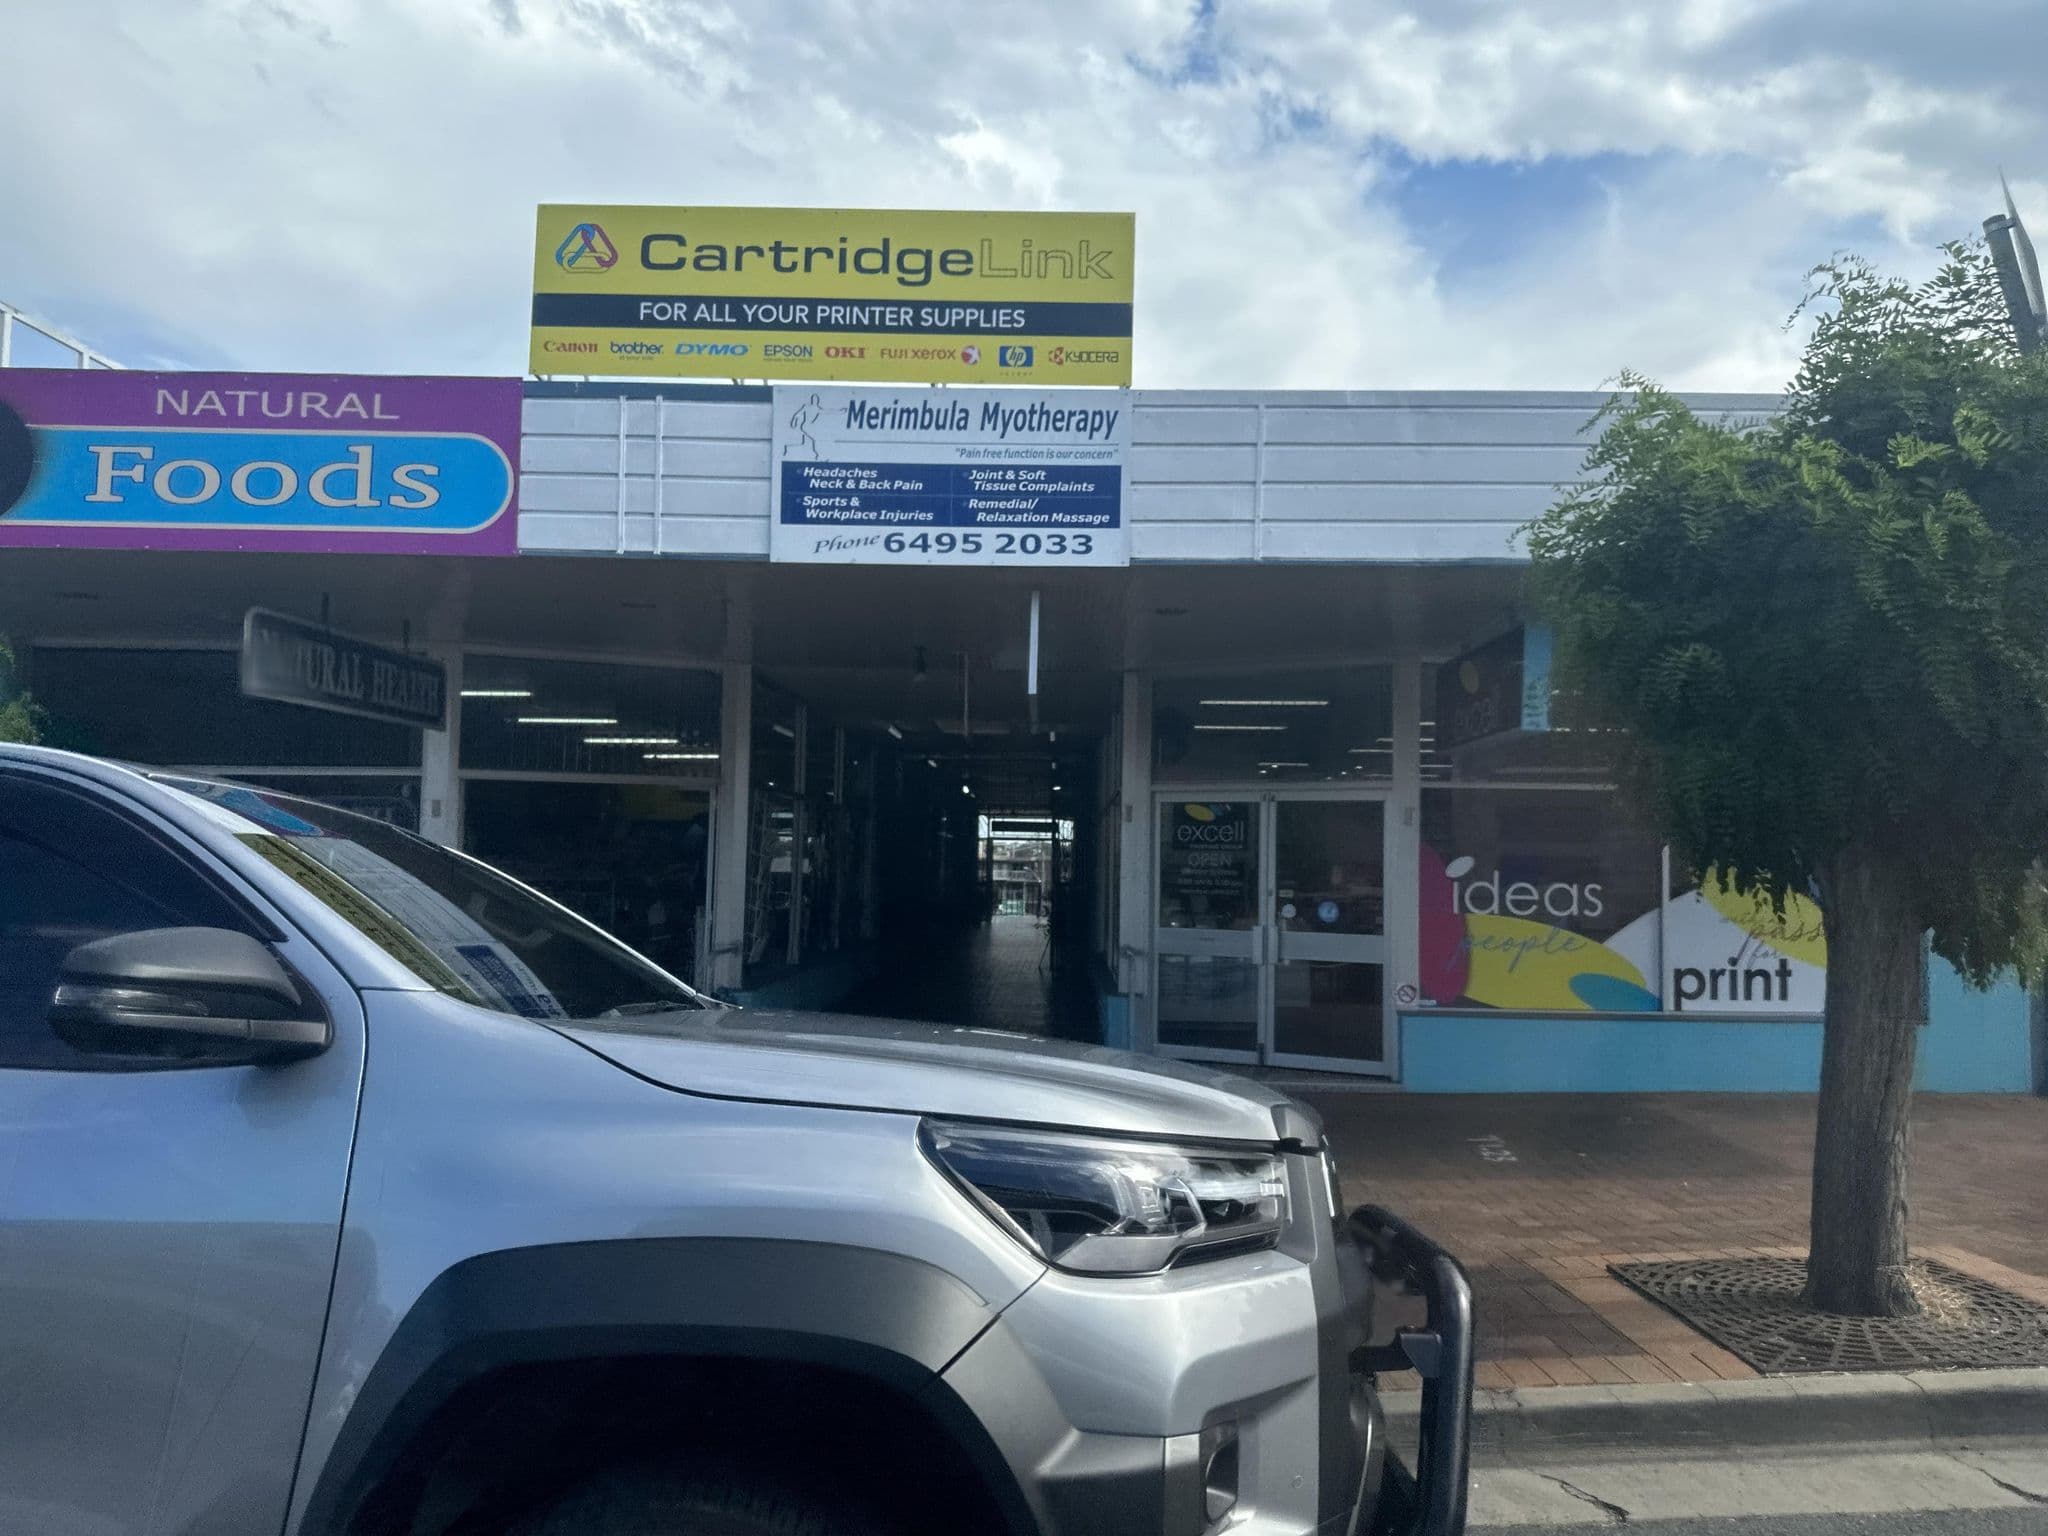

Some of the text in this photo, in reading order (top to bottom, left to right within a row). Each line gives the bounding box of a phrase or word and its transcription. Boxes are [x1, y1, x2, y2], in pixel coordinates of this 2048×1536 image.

[640, 233, 1114, 286] CartridgeLink
[640, 302, 1025, 328] FOR ALL YOUR PRINTER SUPPLIES
[543, 340, 598, 353] Canon
[610, 342, 664, 355] brother
[675, 344, 748, 356] DYMO
[764, 345, 813, 359] EPSON
[825, 346, 867, 359] OKI
[881, 347, 956, 361] FUJI xerox
[156, 390, 399, 419] NATURAL
[846, 399, 1119, 439] Merimbula Myotherapy
[955, 448, 1119, 460] "Pain free function is our concern"
[85, 445, 440, 509] Foods
[803, 467, 878, 478] Headaches
[969, 470, 1047, 480] Joint & Soft
[810, 479, 923, 491] Neck & Back Pain
[974, 481, 1095, 494] Tissue Complaints
[803, 496, 859, 508] Sports &
[969, 498, 1039, 510] Remedial/
[806, 509, 933, 523] Workplace Injuries
[977, 512, 1110, 525] Relaxation Massage
[884, 532, 982, 554] 6495
[995, 534, 1093, 555] 2033
[1177, 821, 1244, 841] excell
[1445, 856, 1603, 917] ideas
[1673, 958, 1792, 1011] print
